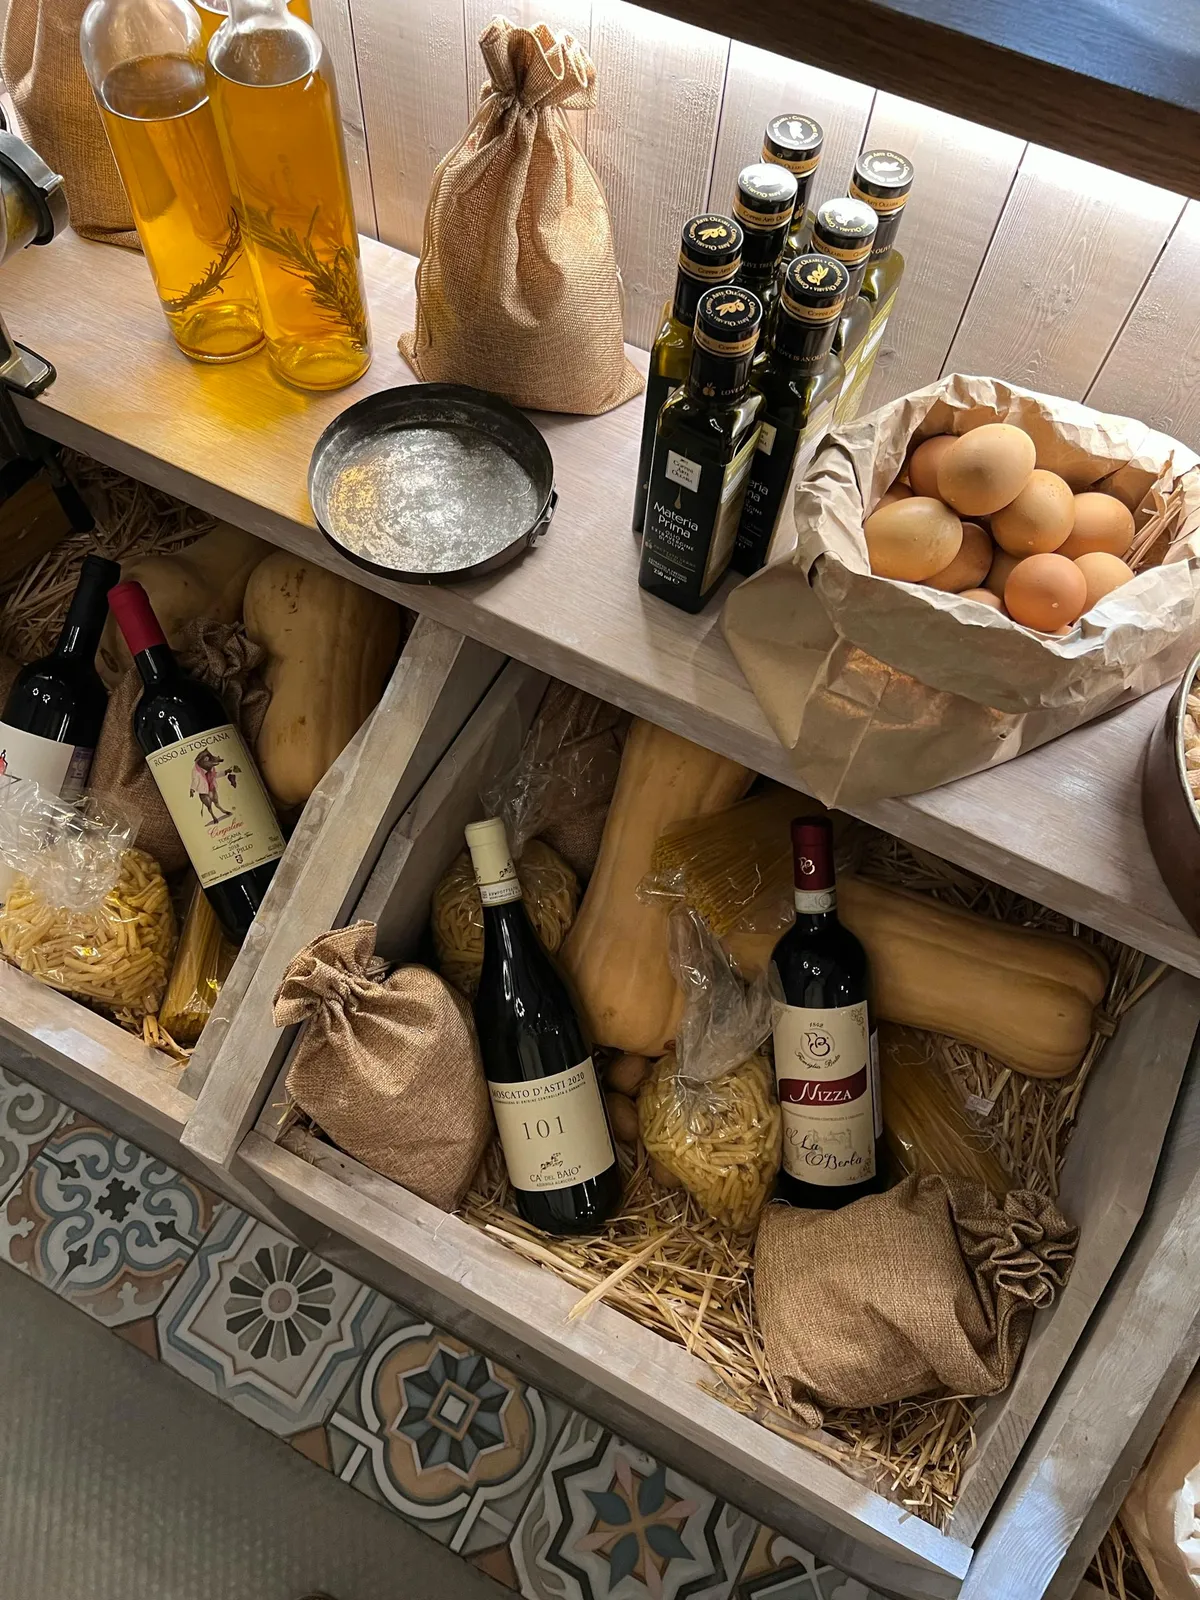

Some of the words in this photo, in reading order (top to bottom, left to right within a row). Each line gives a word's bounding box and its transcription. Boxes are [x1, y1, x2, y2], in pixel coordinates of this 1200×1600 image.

[653, 501, 699, 532] Materia
[658, 514, 691, 539] Prima
[153, 750, 179, 767] ROSSO
[179, 747, 188, 756] di
[187, 732, 230, 752] TOSCANA
[219, 850, 237, 861] VILLA
[491, 1088, 530, 1100] MOSCATO
[532, 1080, 566, 1097] D'ASTI
[568, 1071, 585, 1087] 2020
[789, 1082, 852, 1102] NIZZA
[521, 1115, 566, 1141] 101
